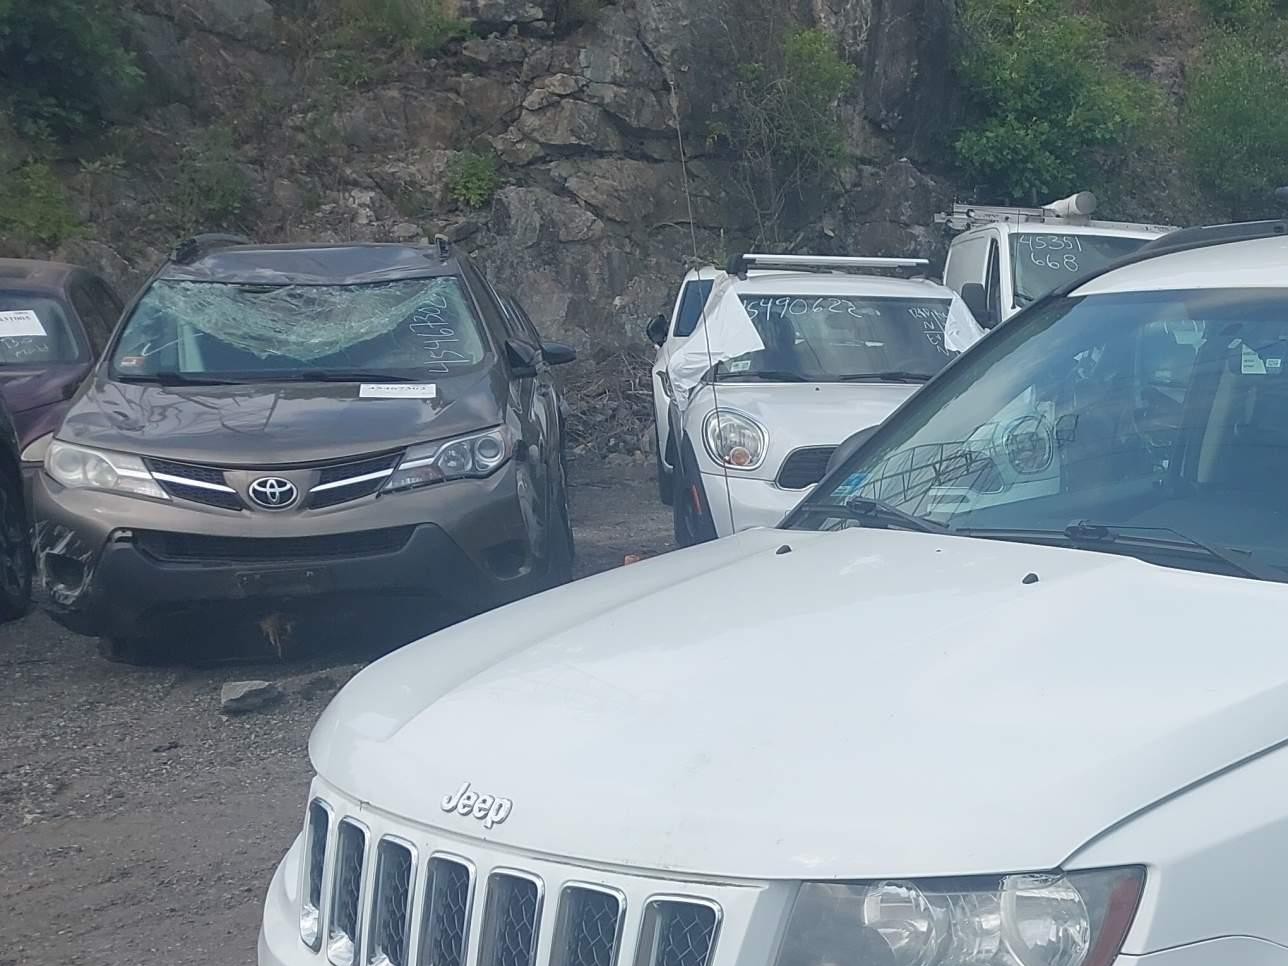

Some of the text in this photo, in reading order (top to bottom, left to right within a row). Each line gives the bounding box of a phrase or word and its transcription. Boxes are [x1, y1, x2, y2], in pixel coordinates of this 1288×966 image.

[1018, 234, 1082, 252] 45351
[1030, 252, 1079, 272] 668
[441, 781, 513, 830] Jeep
